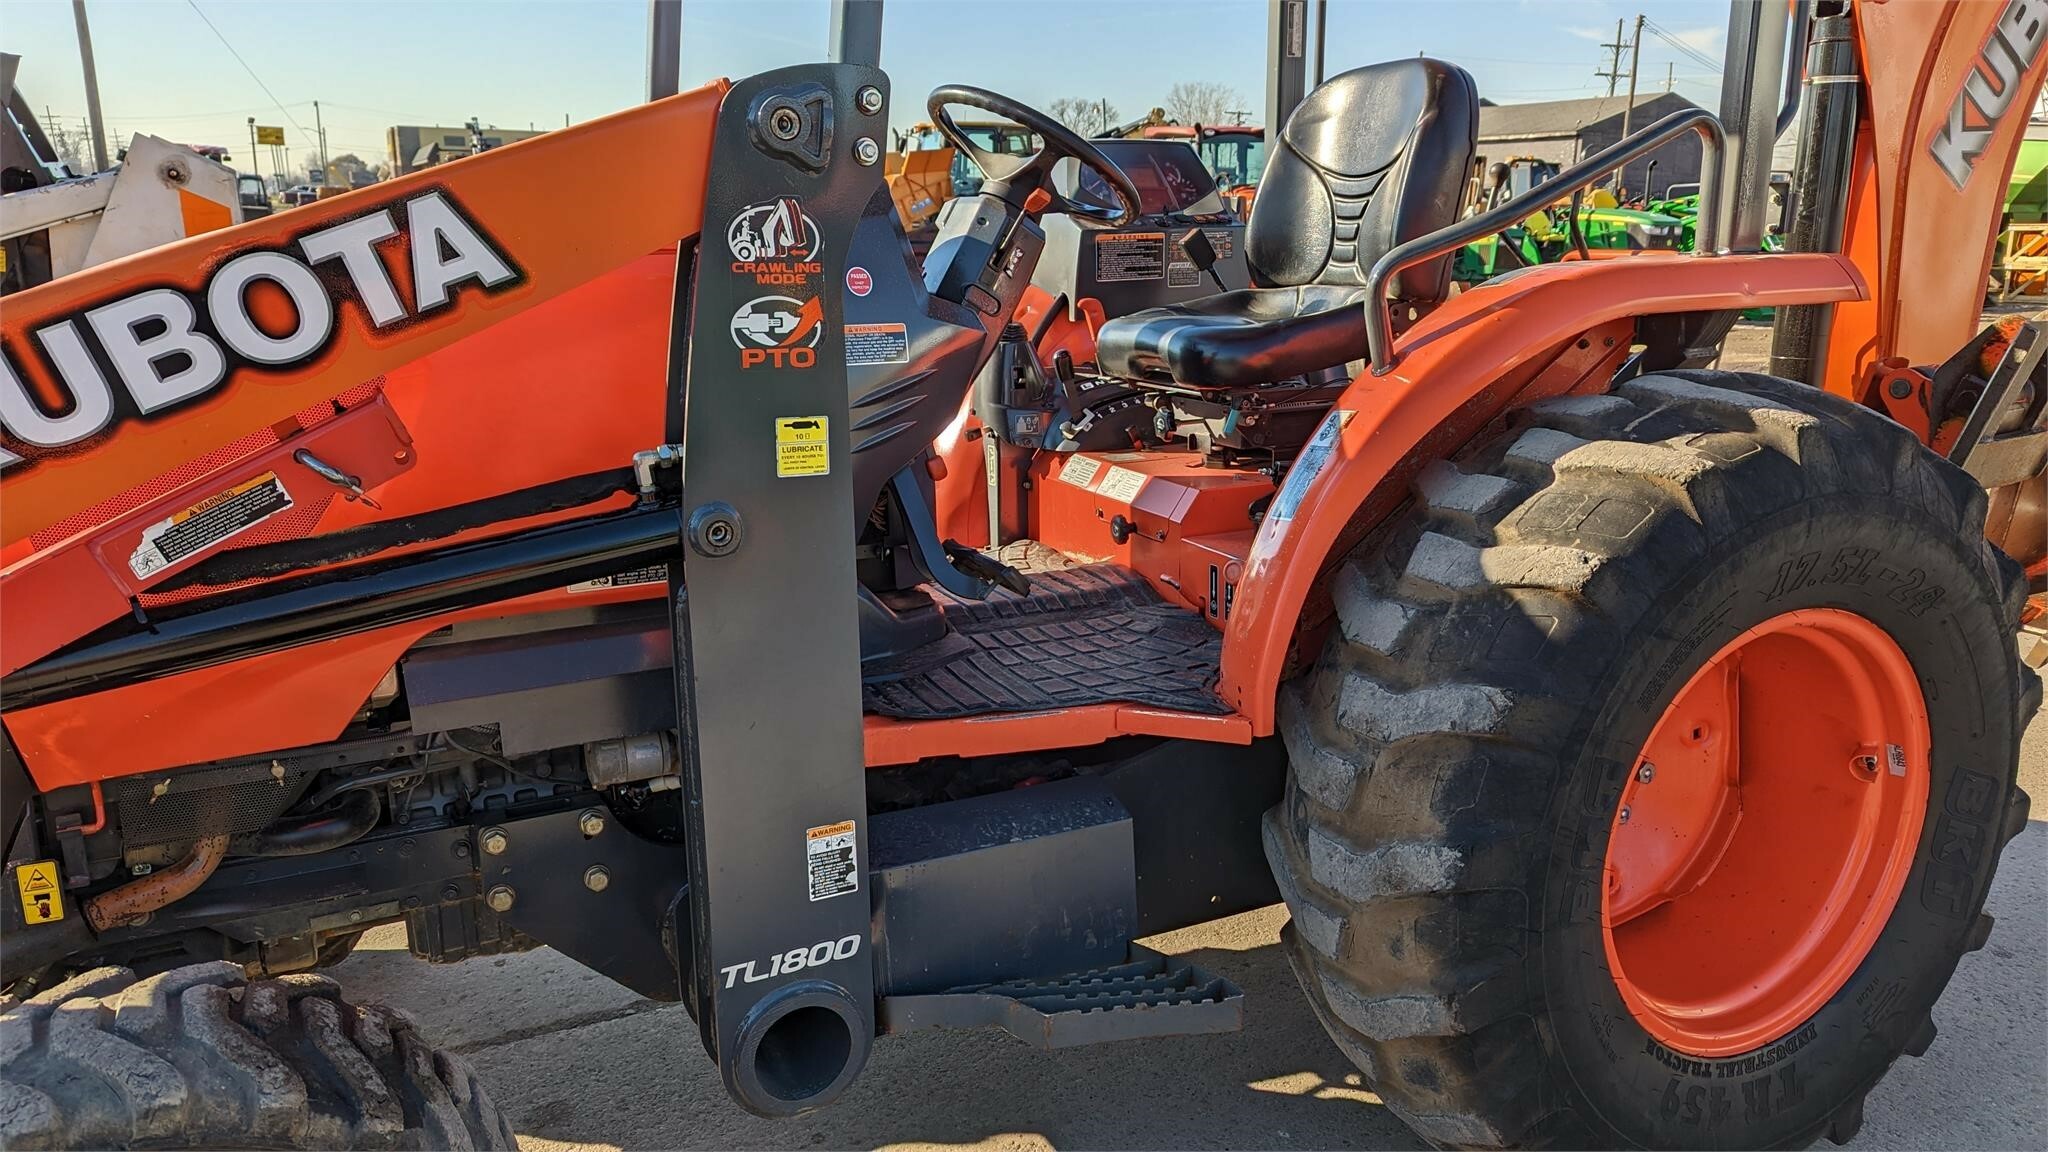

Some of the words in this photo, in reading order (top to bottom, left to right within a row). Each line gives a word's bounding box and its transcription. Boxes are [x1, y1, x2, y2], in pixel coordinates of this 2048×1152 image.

[732, 262, 821, 273] CRAWLING
[756, 273, 807, 285] MODE
[0, 192, 515, 468] UBOTA
[742, 347, 815, 368] PTO
[782, 445, 823, 453] LUBRICATE
[198, 490, 235, 513] WARNING
[817, 824, 851, 836] WARNING
[721, 934, 861, 989] TL1800
[1645, 1038, 1712, 1078] TRACTOR
[1716, 1022, 1817, 1078] INDUSTRIAL
[1660, 1078, 1733, 1129] 459
[1742, 1063, 1805, 1125] TR
